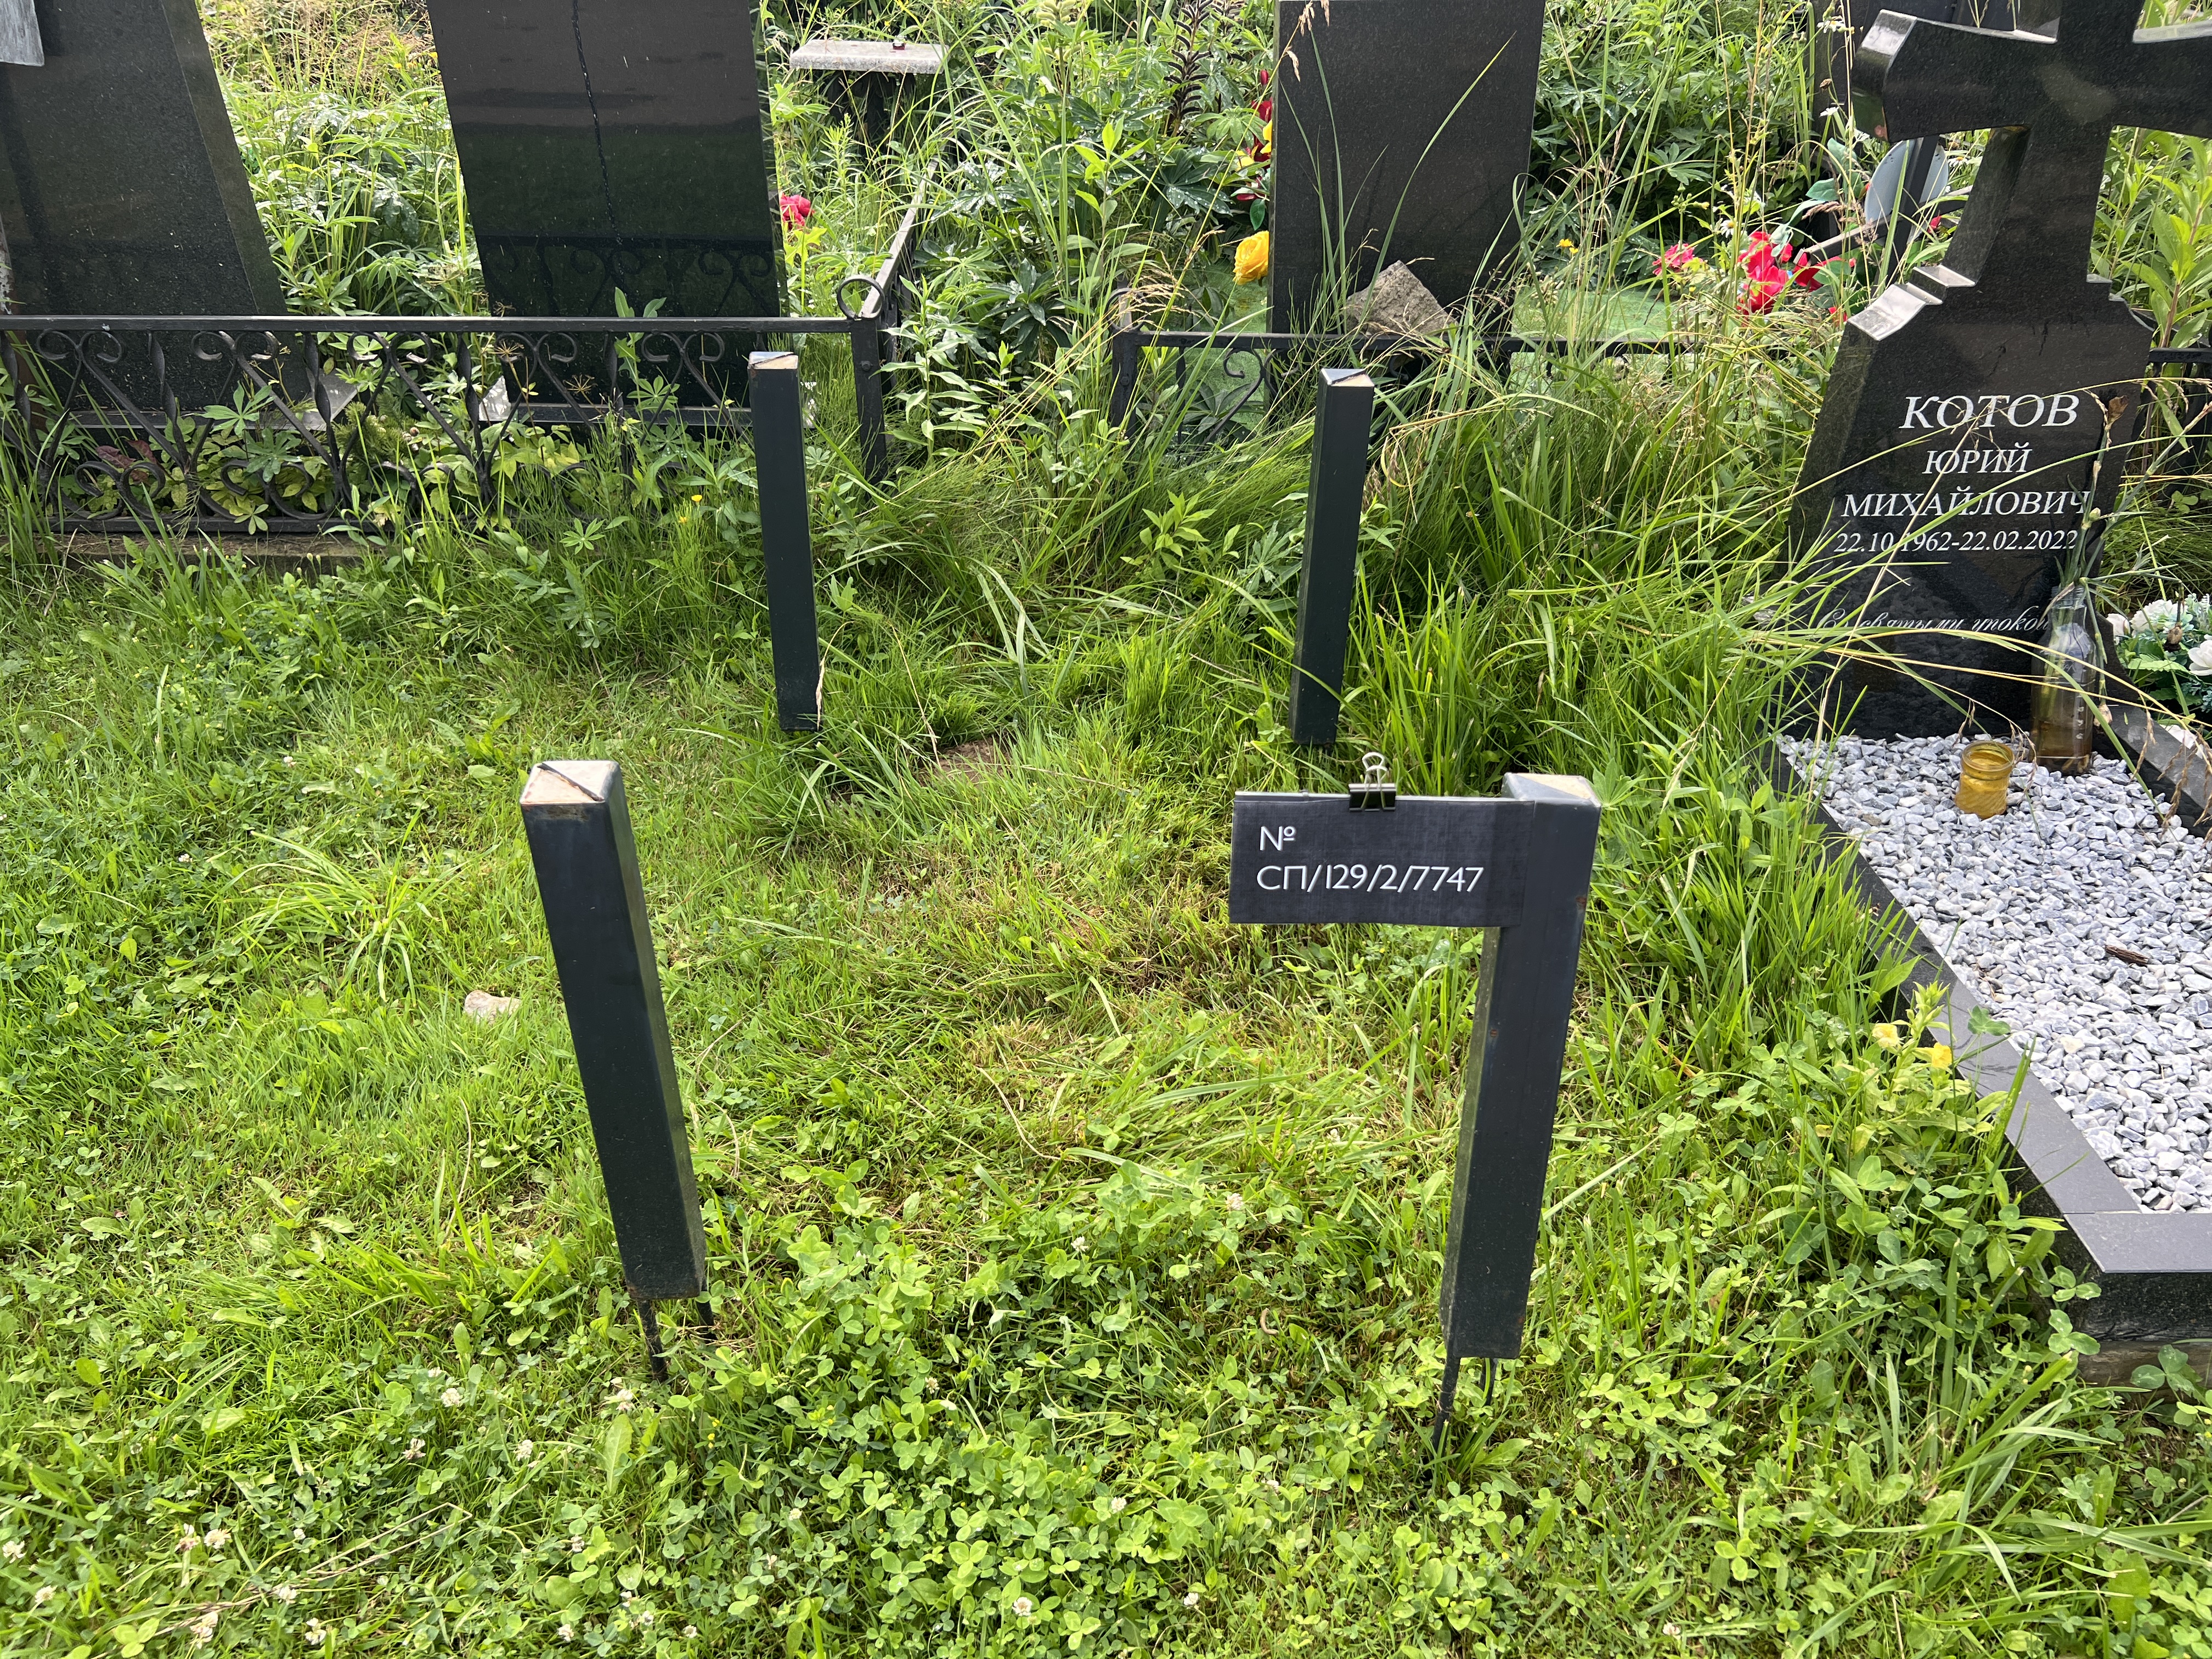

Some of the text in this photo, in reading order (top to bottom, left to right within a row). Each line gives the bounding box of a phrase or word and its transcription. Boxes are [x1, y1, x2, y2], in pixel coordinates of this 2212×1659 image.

[1899, 394, 2080, 428] КОТОВ
[1922, 442, 2033, 474] ЮРИЙ
[1841, 486, 2091, 516] МИХАЙЛОВИЧ
[1833, 530, 2078, 552] 22.101962-22.02.2022
[1817, 608, 1849, 630] С
[1260, 826, 1296, 851] №
[1256, 864, 1484, 893] СП/129/2/7747
